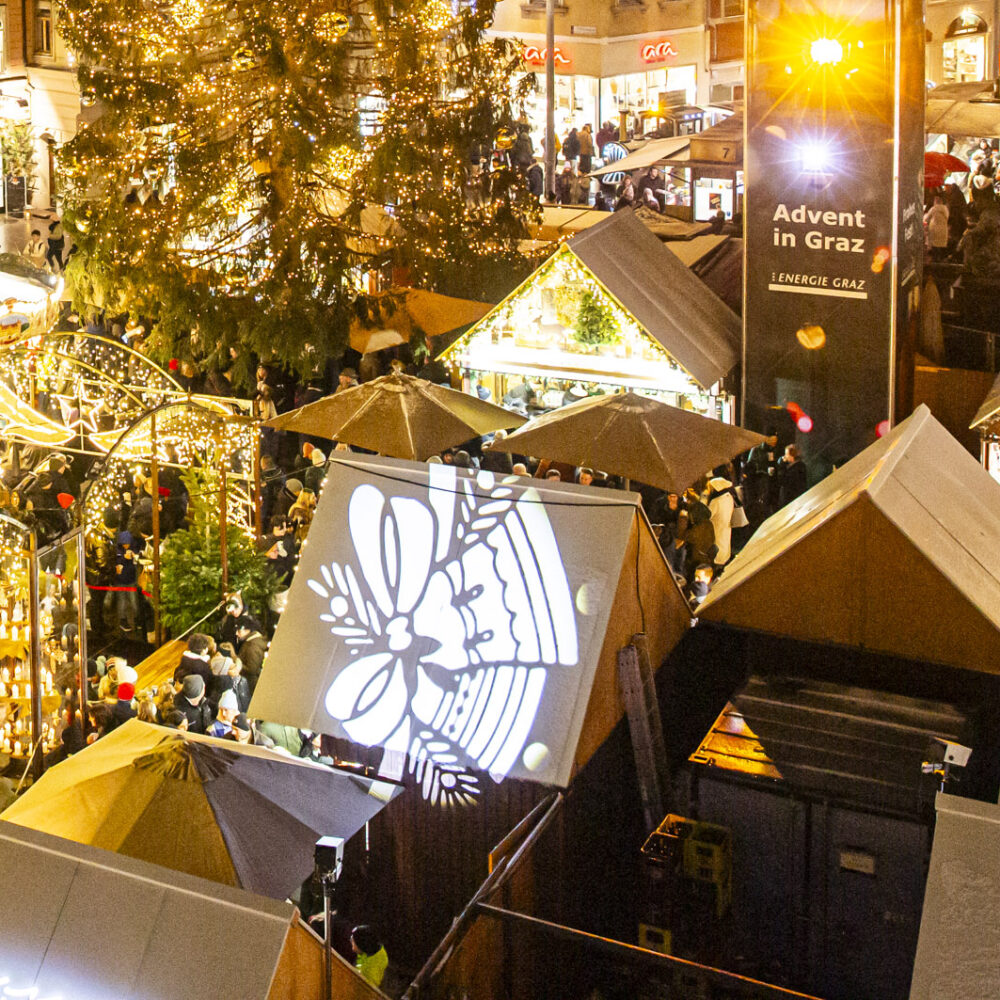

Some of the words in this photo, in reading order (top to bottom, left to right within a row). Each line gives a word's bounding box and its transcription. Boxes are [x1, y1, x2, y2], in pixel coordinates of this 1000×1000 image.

[642, 41, 679, 60] ara
[722, 147, 731, 159] 7
[773, 203, 866, 228] Advent
[773, 227, 796, 248] in
[804, 230, 865, 254] Graz
[778, 272, 829, 287] ENERGIE
[832, 277, 866, 290] GRAZ
